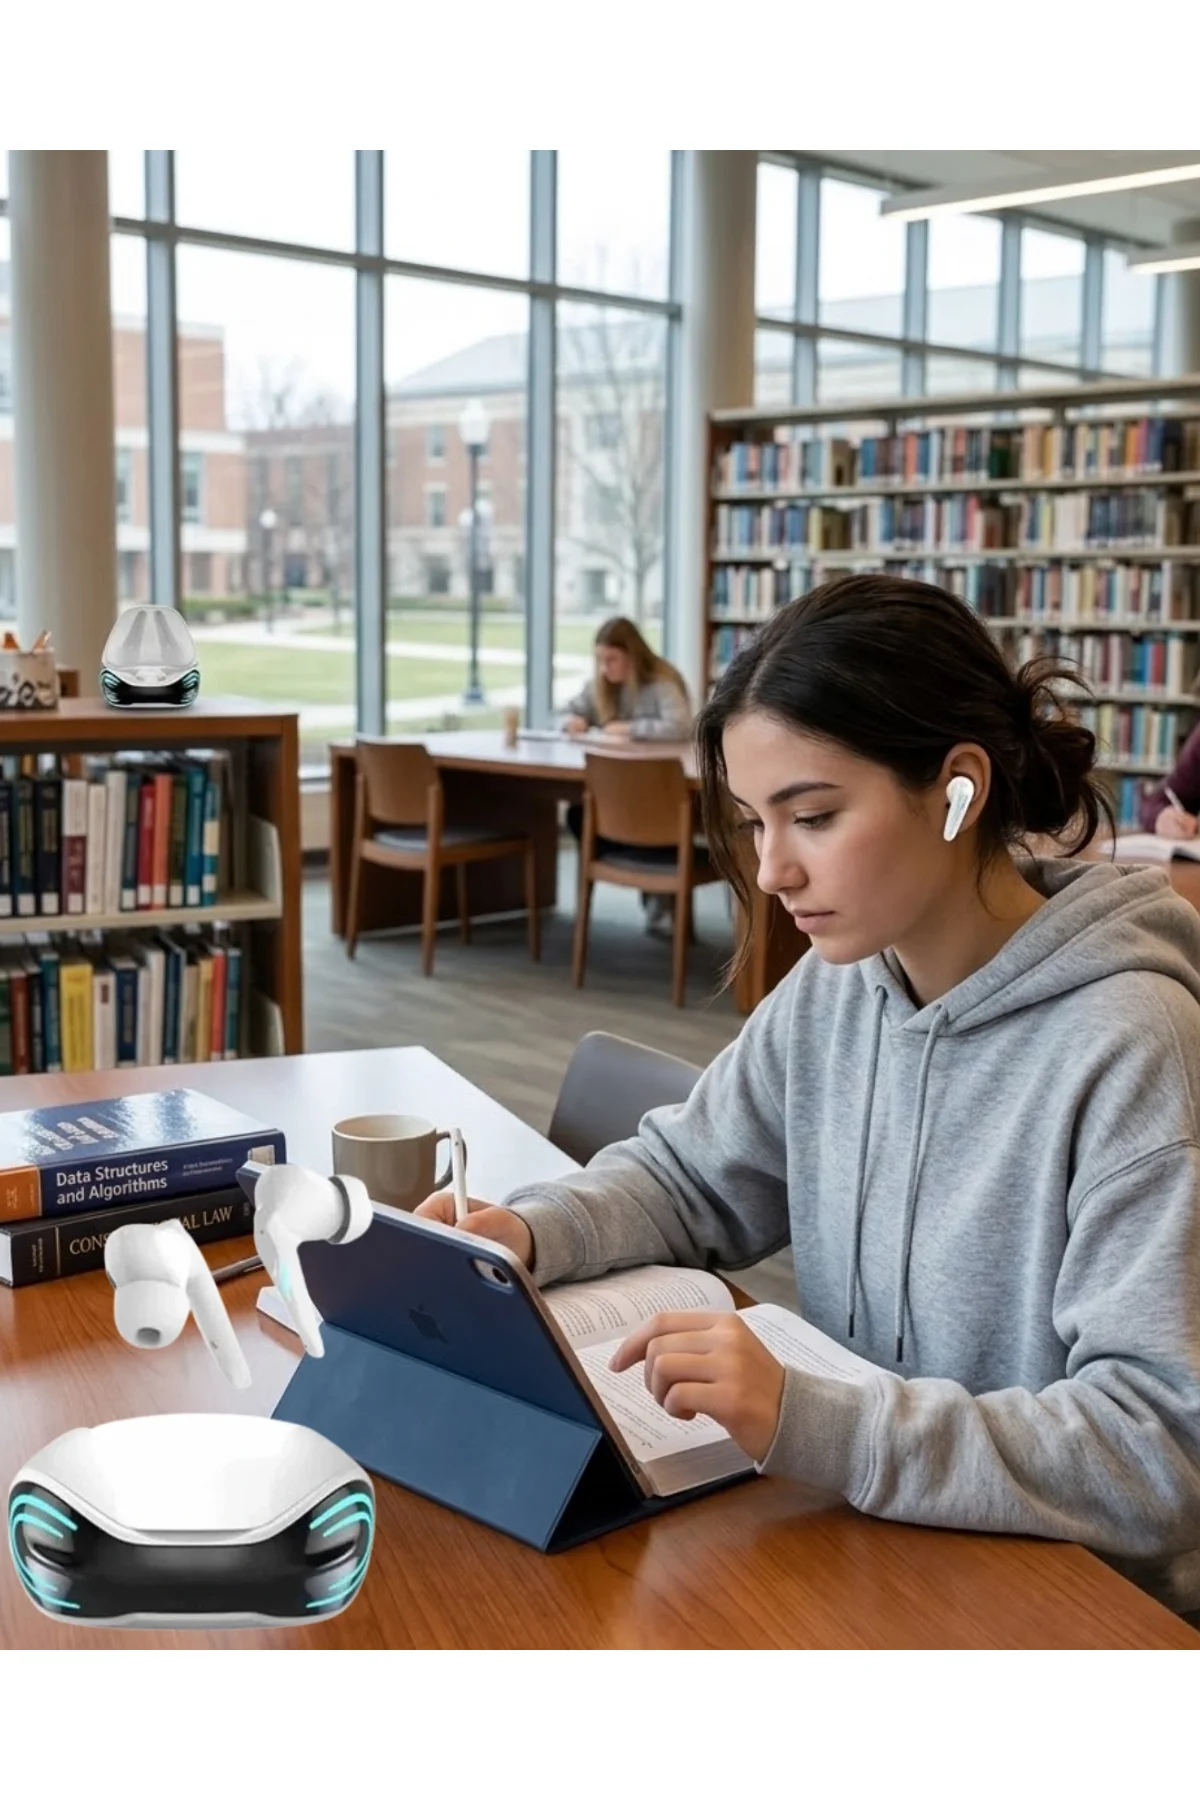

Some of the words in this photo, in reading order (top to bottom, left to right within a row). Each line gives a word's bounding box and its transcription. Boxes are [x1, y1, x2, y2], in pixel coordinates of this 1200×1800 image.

[56, 1171, 91, 1187] Data
[95, 1160, 169, 1181] Structures
[57, 1187, 85, 1205] and
[88, 1177, 168, 1201] Algorithms
[203, 1206, 234, 1226] LAW
